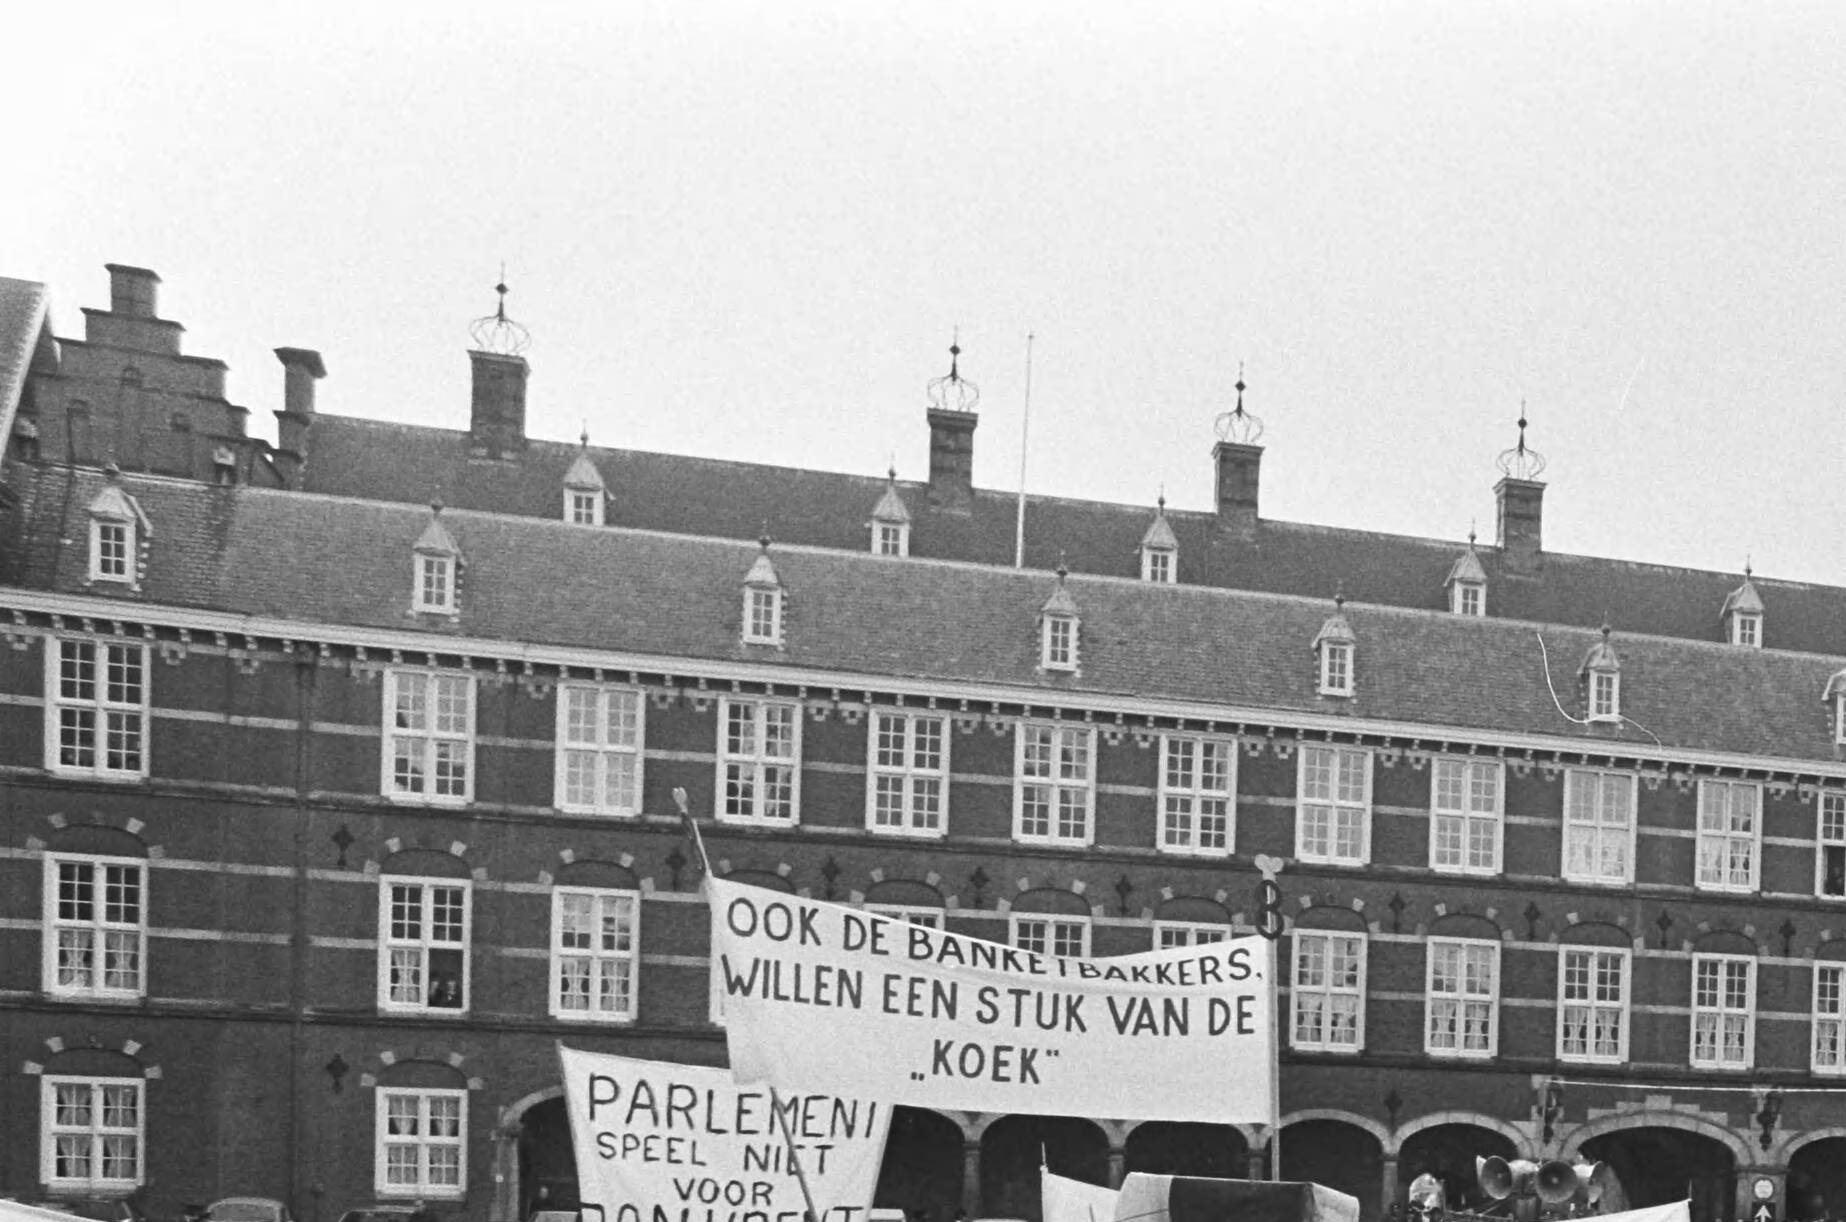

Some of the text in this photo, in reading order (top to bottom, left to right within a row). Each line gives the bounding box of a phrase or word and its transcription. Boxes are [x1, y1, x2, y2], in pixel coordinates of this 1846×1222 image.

[727, 897, 821, 945] OOK
[843, 914, 890, 956] DE
[721, 954, 1255, 1036] WILLEN EEN STUK VAN DE
[597, 1132, 834, 1175] SPEEL NIET
[673, 1178, 775, 1206] VOOR
